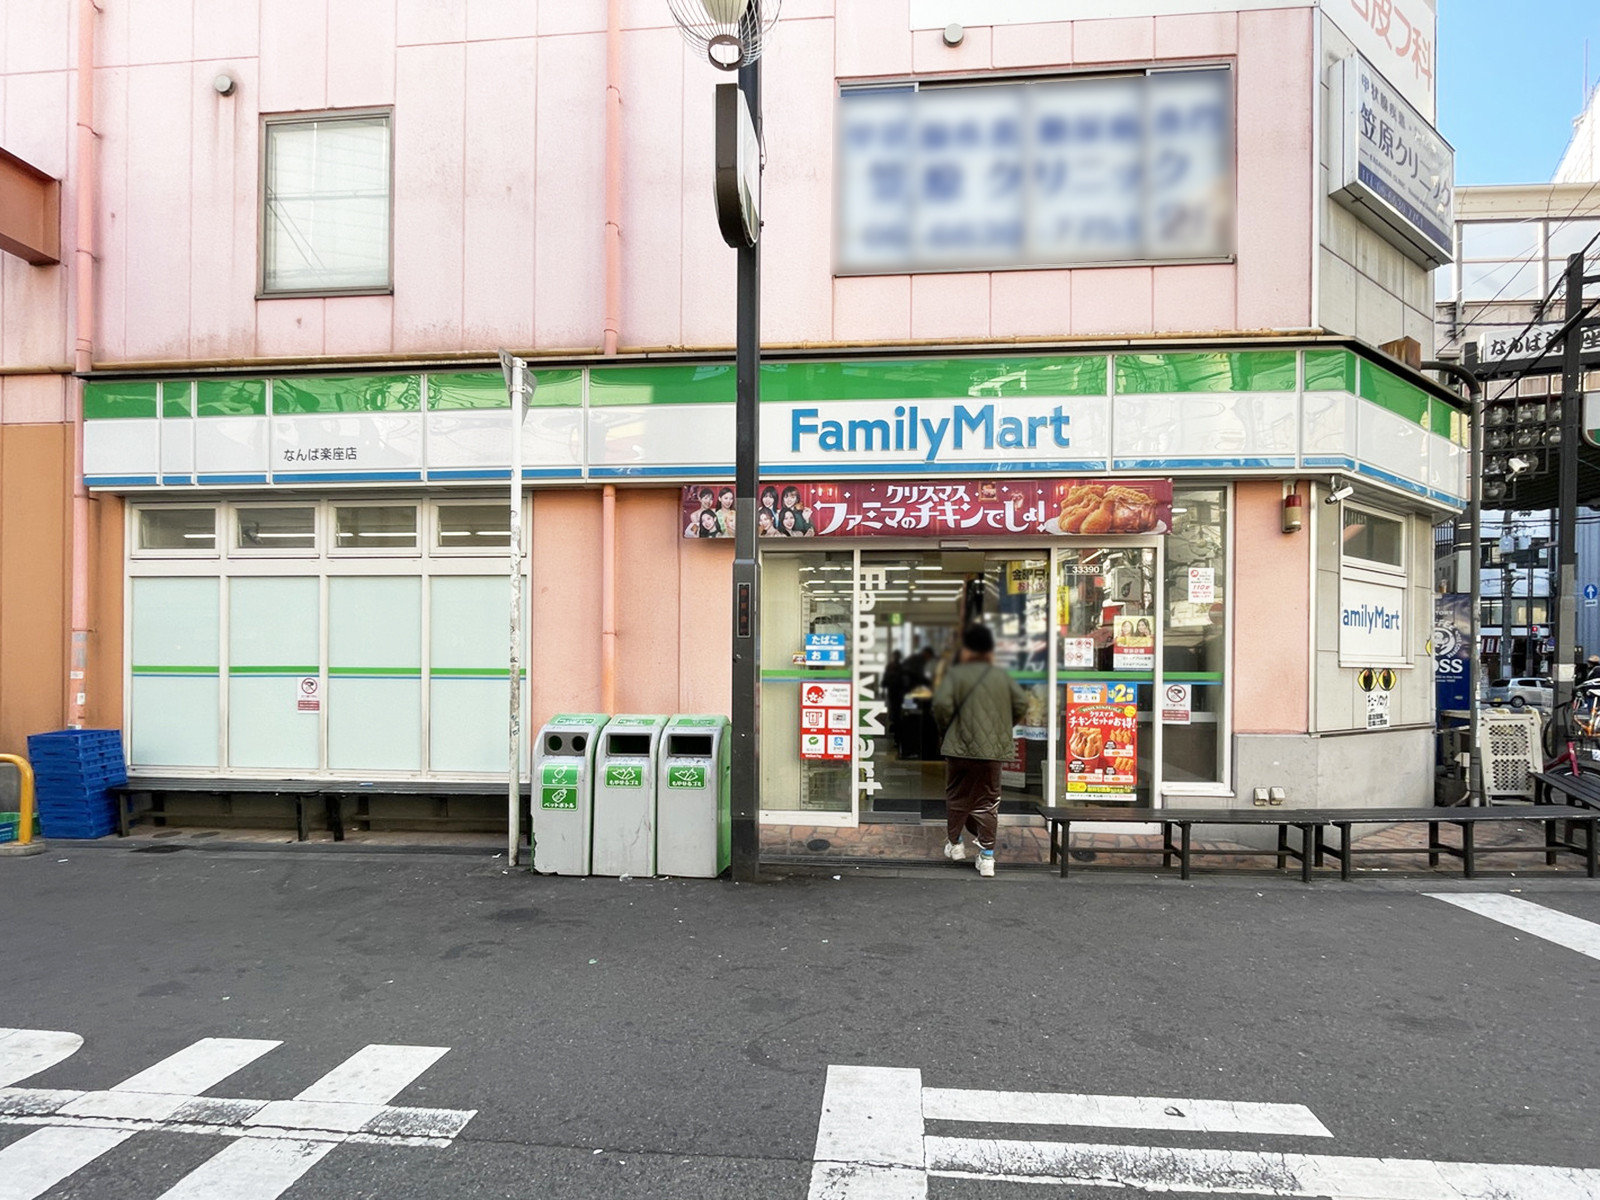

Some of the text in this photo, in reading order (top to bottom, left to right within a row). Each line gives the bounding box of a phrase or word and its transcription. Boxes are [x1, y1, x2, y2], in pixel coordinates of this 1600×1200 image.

[791, 405, 1071, 464] FamilyMart
[283, 446, 357, 462] なんば楽座店
[886, 485, 970, 503] クリスマス
[1072, 566, 1100, 574] 33390
[812, 635, 839, 645] たばこ
[859, 568, 888, 796] FamilyMart
